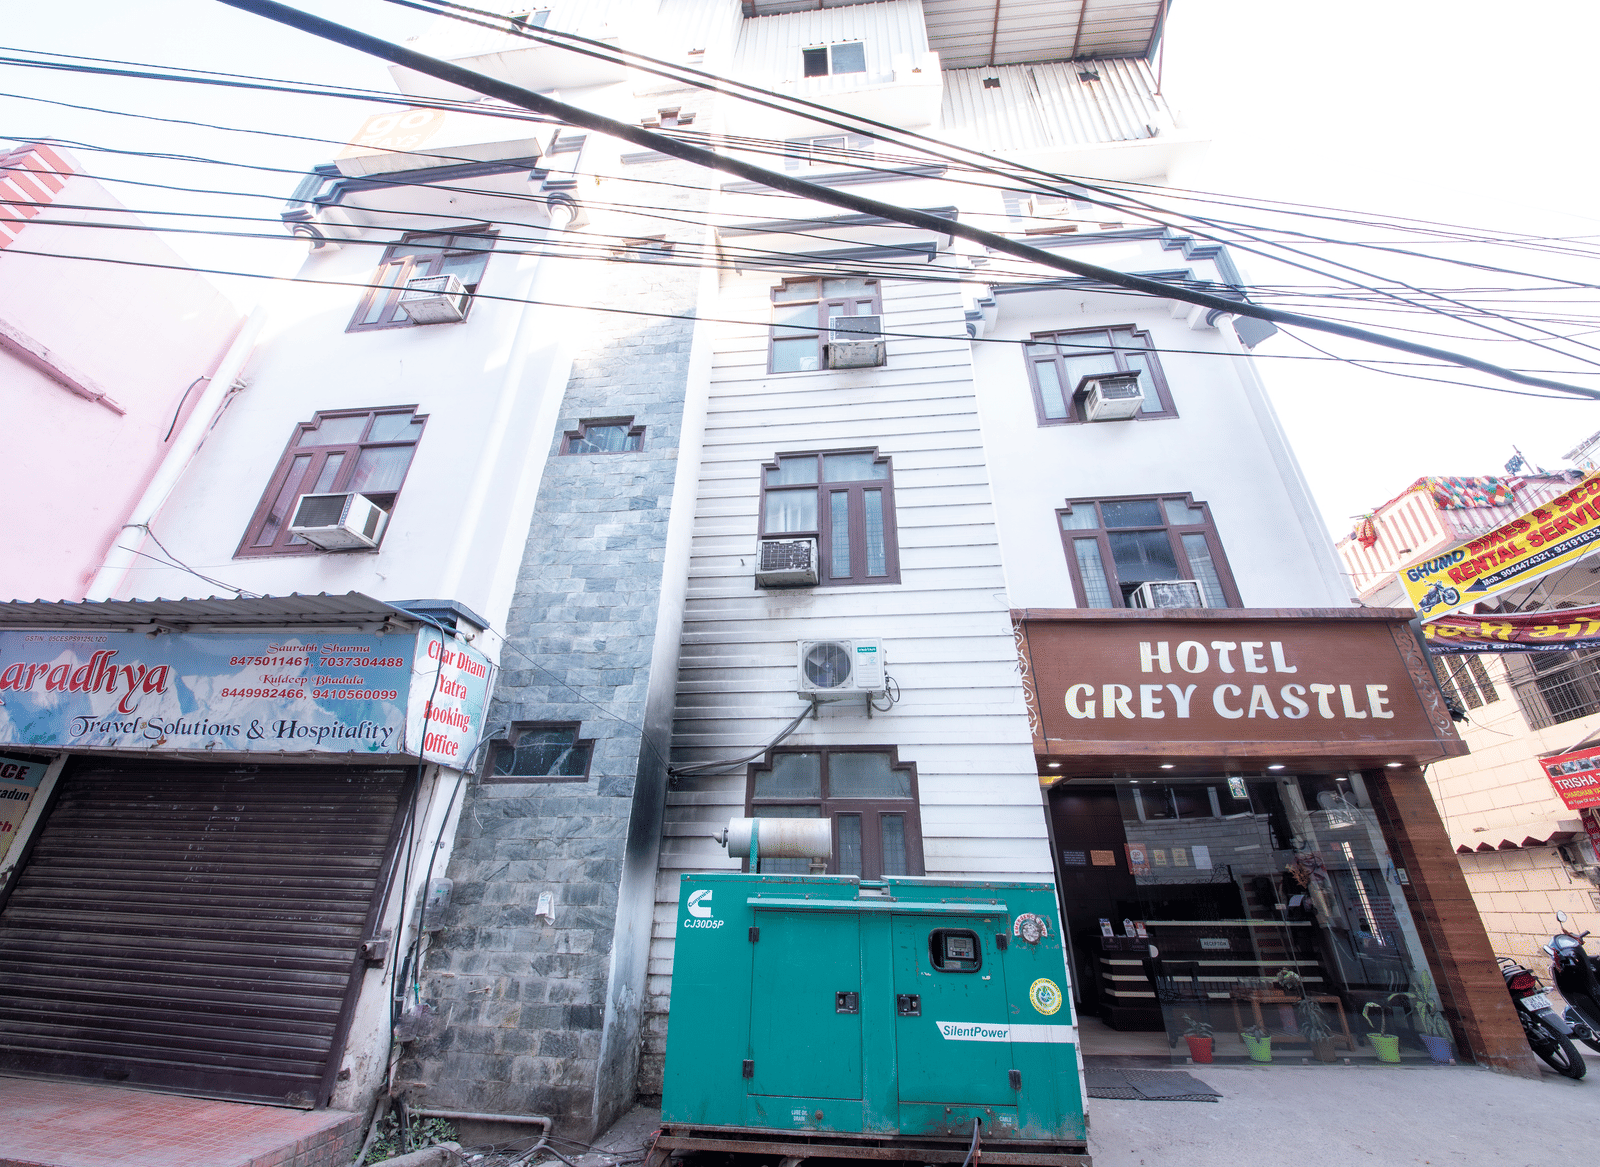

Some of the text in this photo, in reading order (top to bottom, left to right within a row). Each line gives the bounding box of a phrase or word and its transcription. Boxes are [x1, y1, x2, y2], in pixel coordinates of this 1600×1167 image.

[1406, 549, 1466, 583] GHUMO
[1465, 519, 1531, 556] BIKES
[1532, 509, 1553, 525] &
[1447, 541, 1527, 584] RENTAL
[229, 656, 404, 668] 8475011461, 7037304488
[266, 643, 370, 655] Saurabh Sharma
[1139, 640, 1297, 674] HOTEL
[457, 652, 486, 679] Dham
[0, 650, 171, 714] aradhya
[221, 687, 398, 700] 8449982466, 9410560099
[259, 674, 364, 688] Kuldeep Bhadula
[439, 674, 467, 700] Yatra
[1064, 683, 1395, 719] GREY CASTLE
[424, 700, 471, 733] Booking
[69, 716, 394, 748] Travel Solutions & Hospitality
[424, 732, 459, 757] Office
[1555, 774, 1598, 790] TRISHA
[684, 919, 725, 929] CJ30D5P
[943, 1025, 1009, 1039] SilentPower
